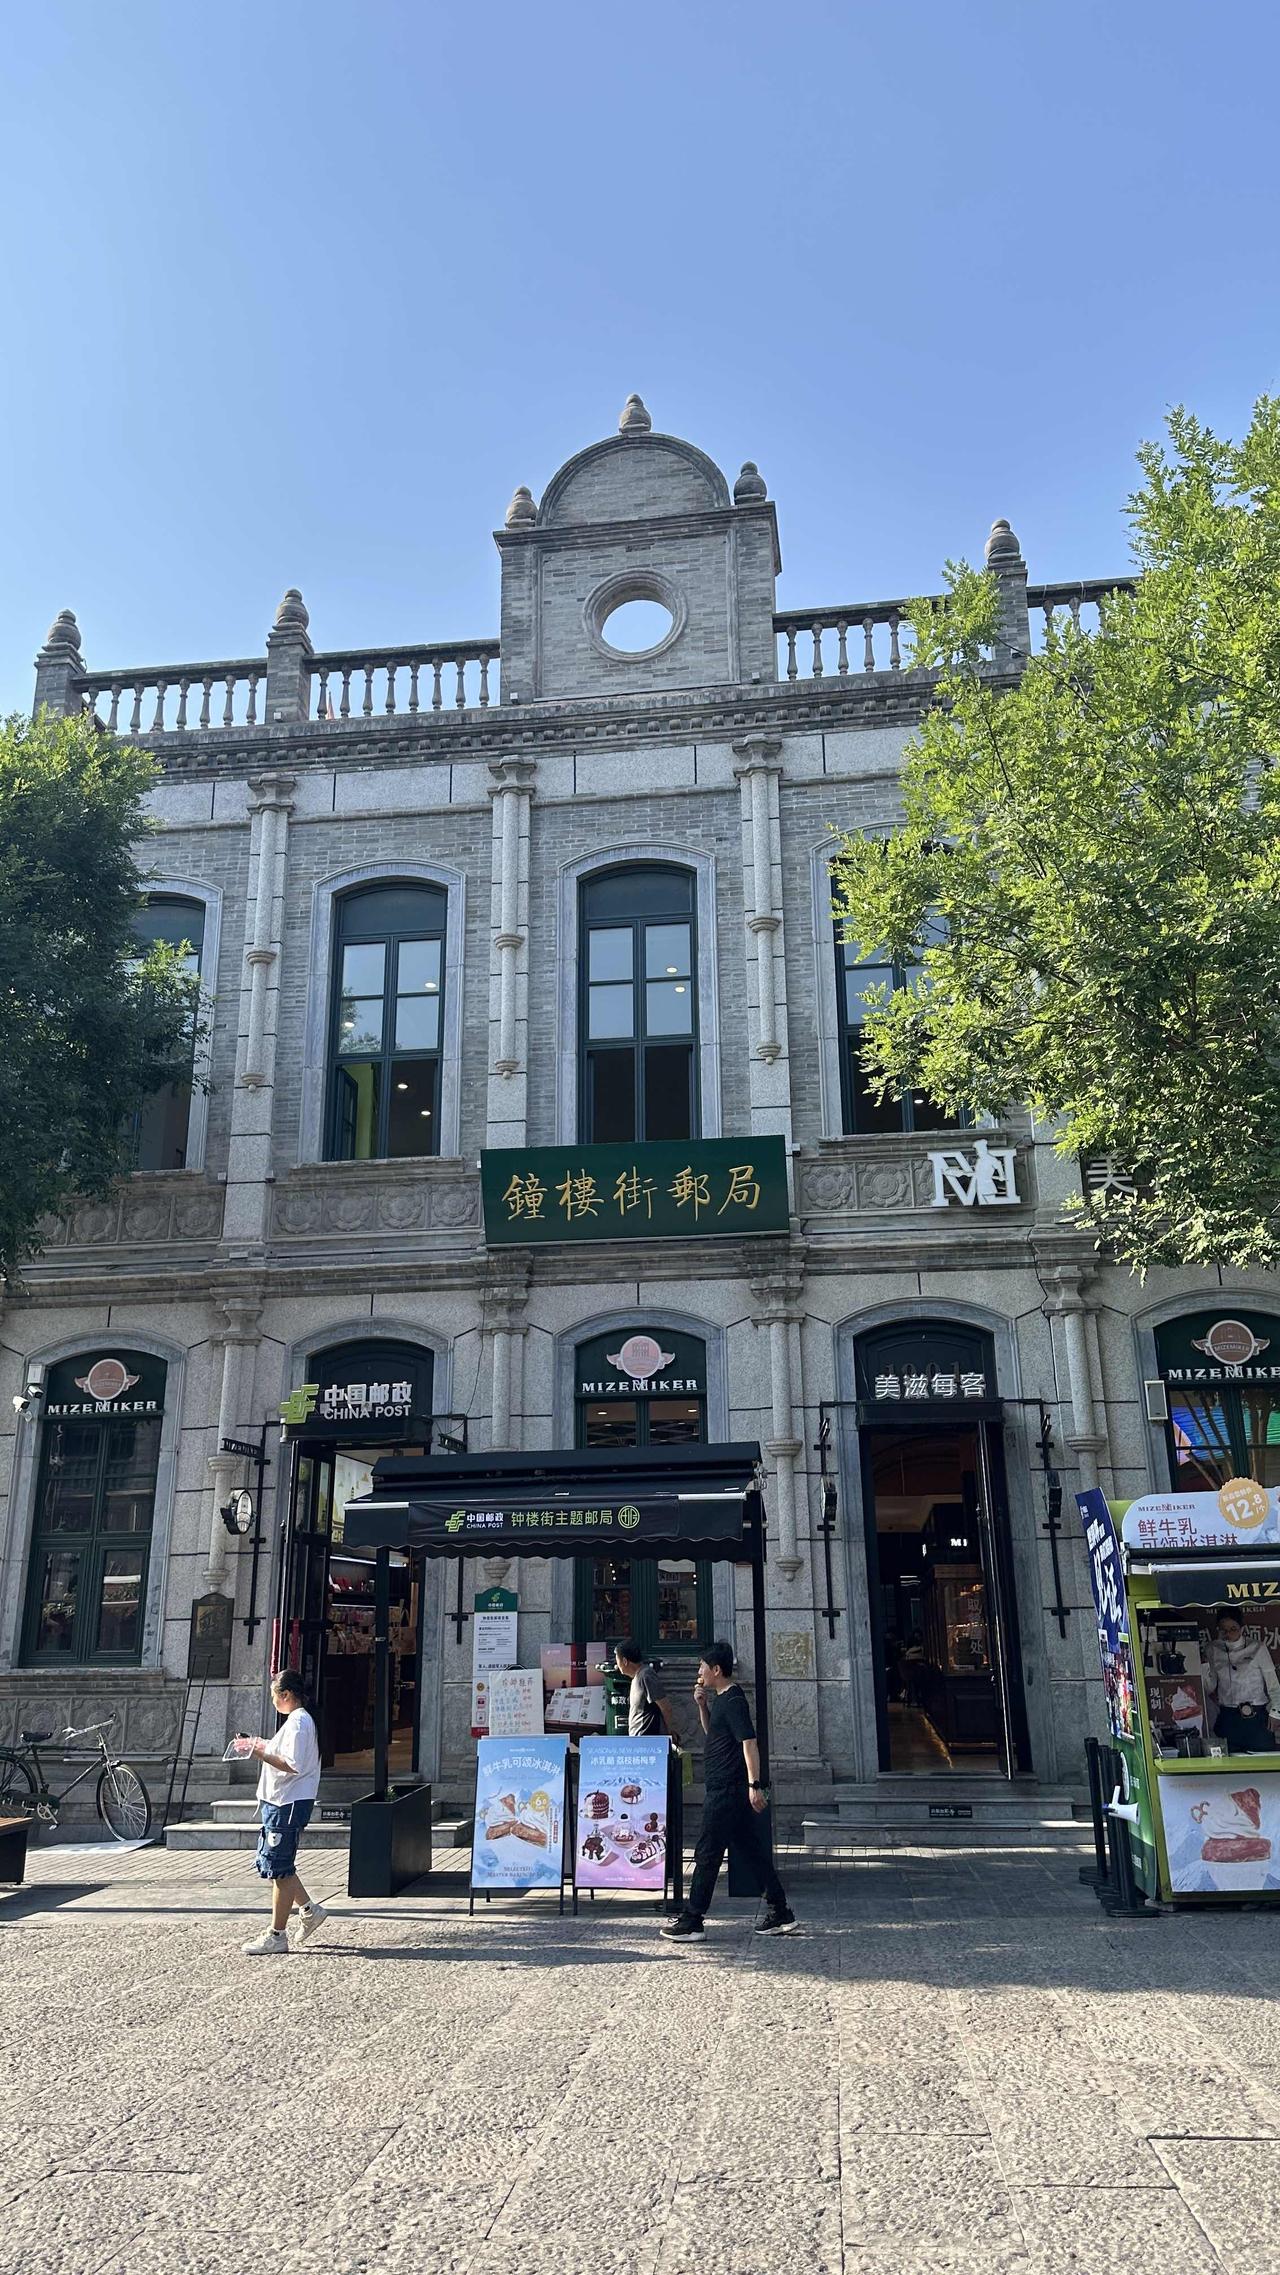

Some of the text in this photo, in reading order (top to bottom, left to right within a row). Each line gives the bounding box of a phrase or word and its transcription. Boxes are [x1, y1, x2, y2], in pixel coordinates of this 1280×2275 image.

[501, 1164, 761, 1222] 鐘樓街郵局
[324, 1381, 413, 1407] 中国邮政
[874, 1372, 987, 1400] 美滋每客
[324, 1404, 412, 1420] CHINA POST
[467, 1512, 504, 1522] 中国邮政
[511, 1510, 613, 1527] 钟楼街主题邮局
[1138, 1517, 1197, 1537] 鲜牛乳
